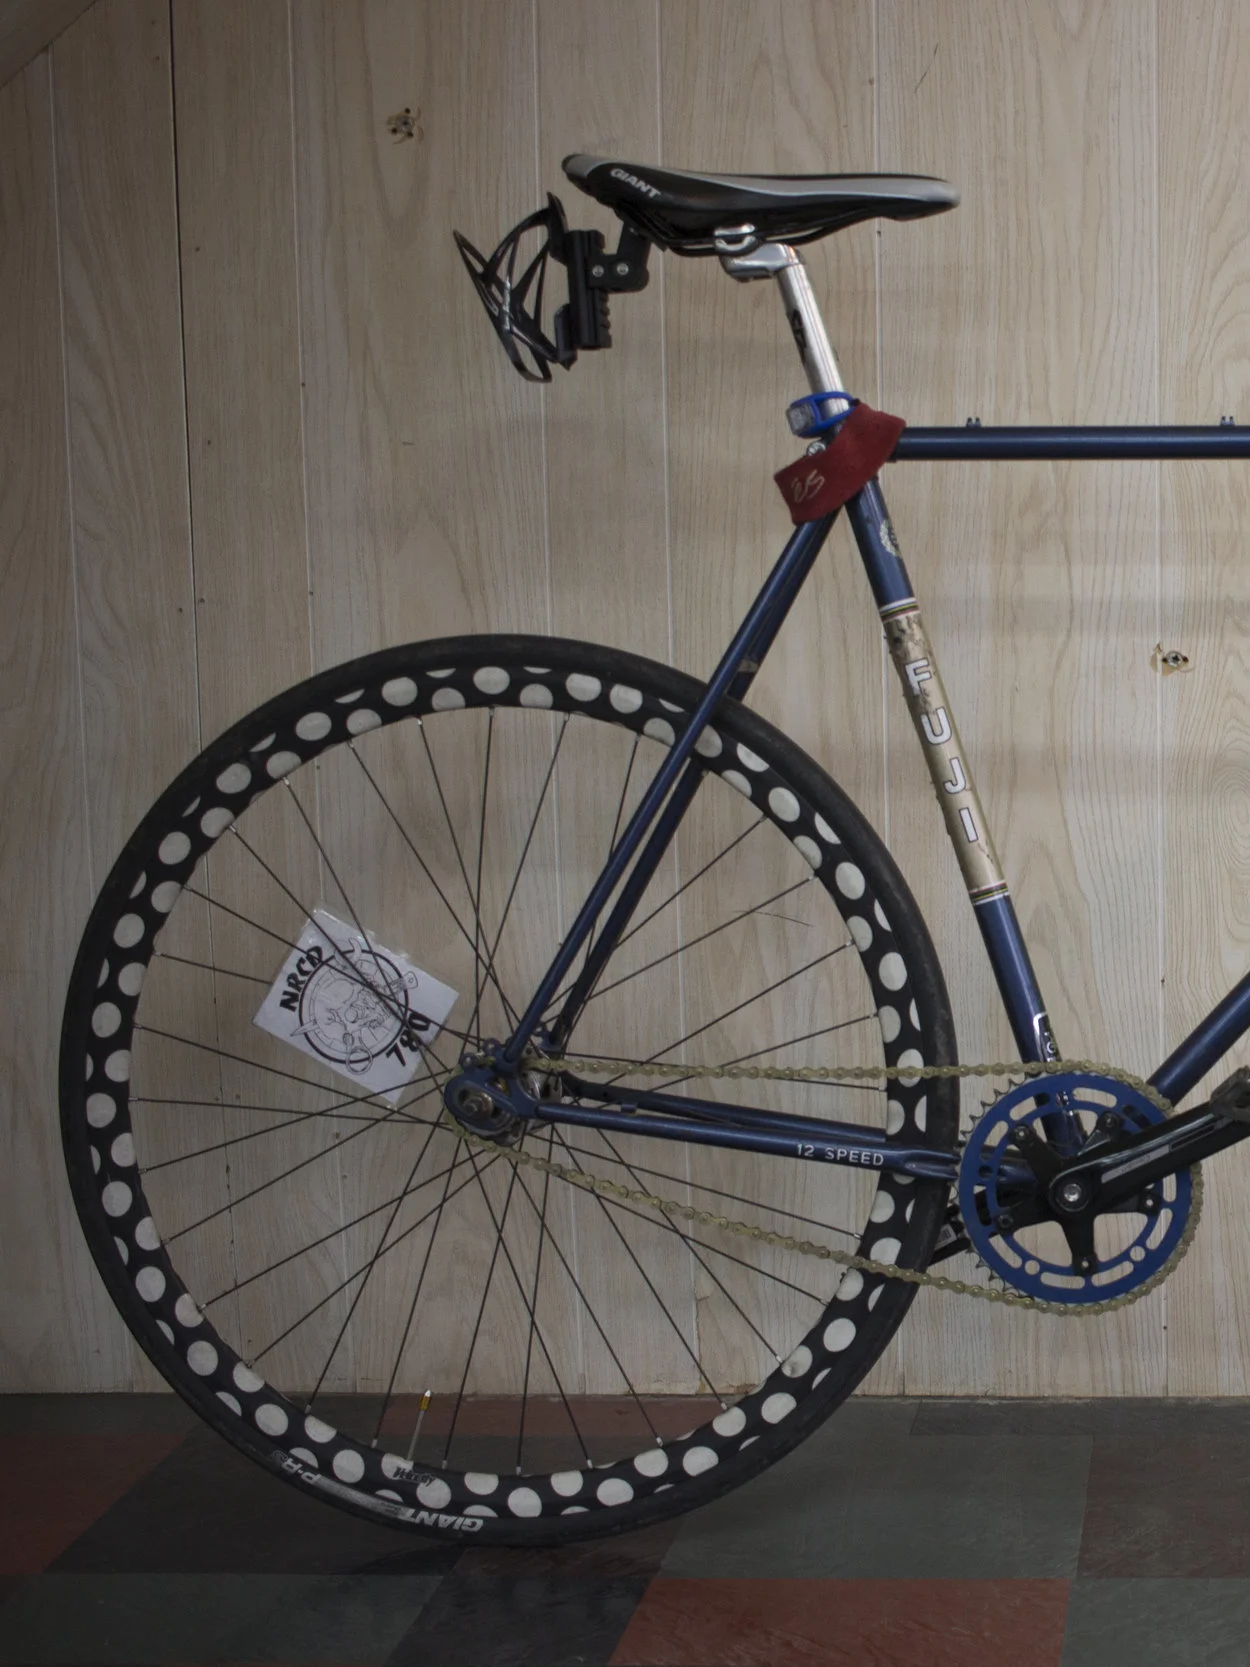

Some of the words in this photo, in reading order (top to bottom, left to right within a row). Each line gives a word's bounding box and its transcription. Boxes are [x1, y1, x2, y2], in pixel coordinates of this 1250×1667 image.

[609, 166, 662, 200] GIANT
[904, 656, 979, 844] FUJI
[796, 1143, 815, 1158] 12
[824, 1147, 885, 1166] SPEED
[400, 1507, 484, 1533] GIANT
